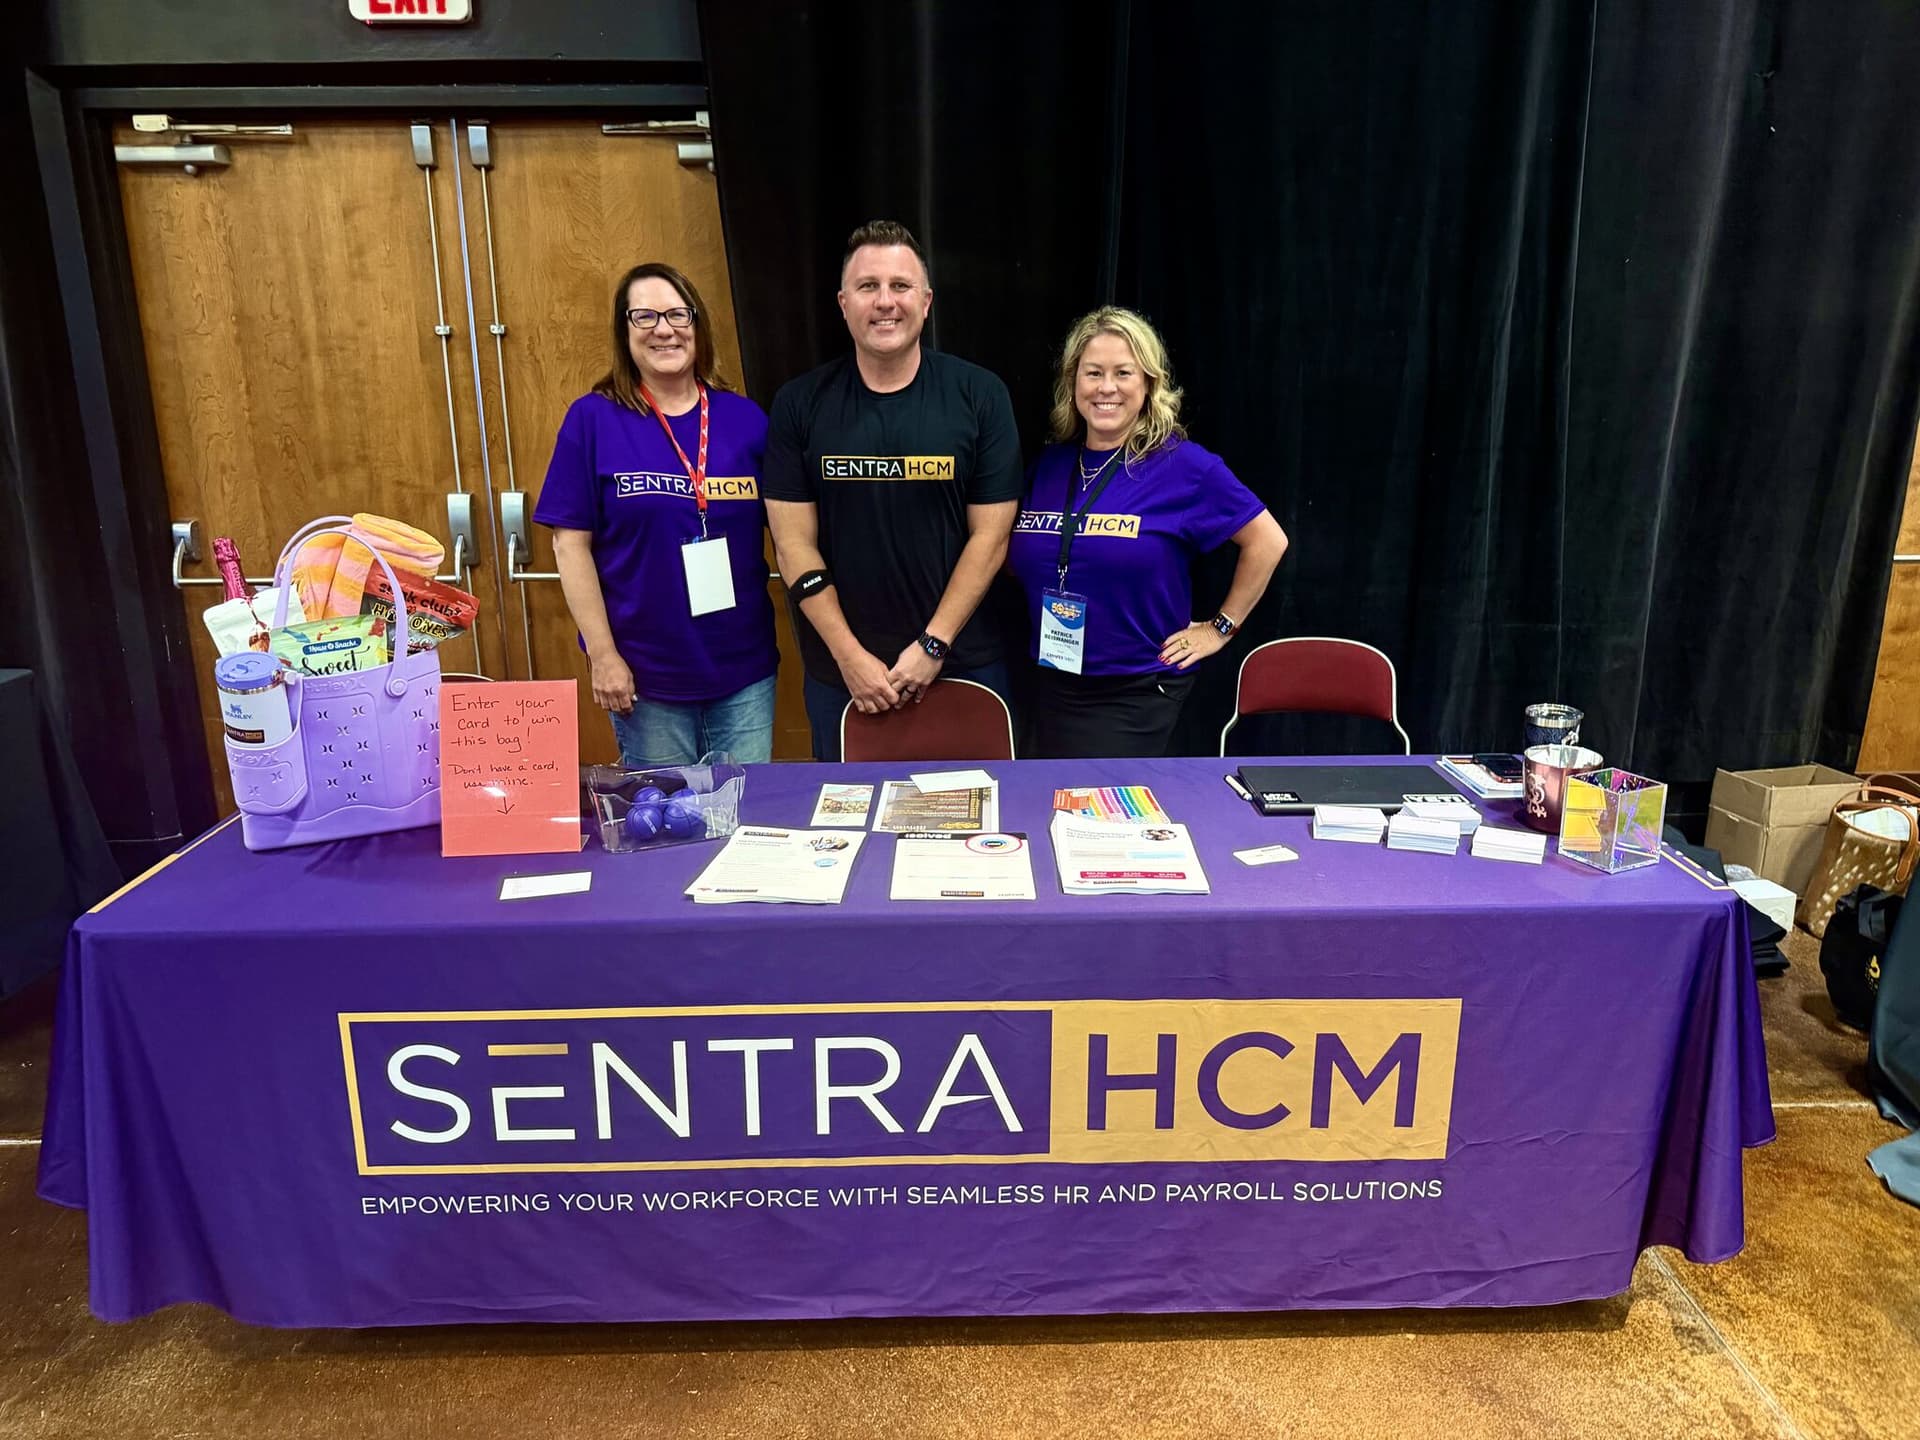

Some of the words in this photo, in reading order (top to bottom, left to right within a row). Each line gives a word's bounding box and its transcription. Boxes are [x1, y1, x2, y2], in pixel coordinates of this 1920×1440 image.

[820, 460, 903, 477] SENTRA
[908, 461, 951, 476] HCM
[707, 481, 754, 496] HCM
[1088, 518, 1136, 533] HCM
[452, 694, 500, 712] Enter
[515, 699, 555, 717] your
[504, 715, 520, 726] to
[531, 714, 561, 725] win
[450, 735, 487, 747] this
[448, 763, 482, 775] Don't
[489, 764, 513, 773] have
[518, 764, 527, 772] a
[386, 1033, 1024, 1144] SENTRA
[1086, 1031, 1422, 1131] HCM
[361, 1193, 551, 1215] EMPOWERING
[558, 1191, 634, 1213] YOUR
[643, 1189, 819, 1212] WORKFORCE
[828, 1186, 897, 1206] WITH
[907, 1184, 1045, 1204] SEAMLESS
[1054, 1185, 1090, 1204] HR
[1098, 1183, 1156, 1203] AND
[1166, 1182, 1284, 1202] PAYROLL
[1293, 1179, 1442, 1202] SOLUTIONS
